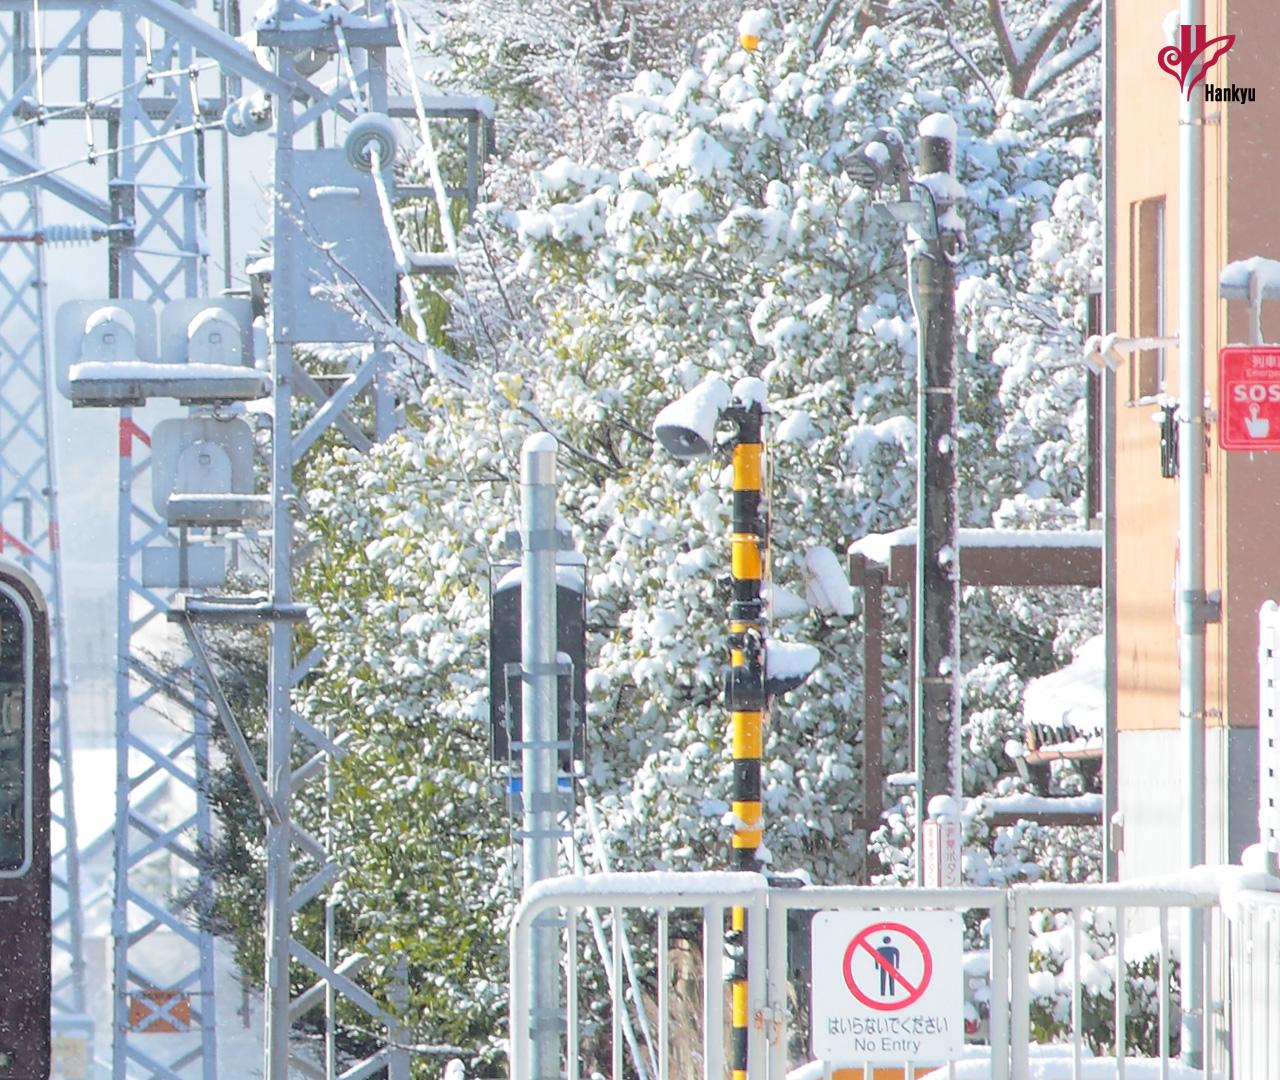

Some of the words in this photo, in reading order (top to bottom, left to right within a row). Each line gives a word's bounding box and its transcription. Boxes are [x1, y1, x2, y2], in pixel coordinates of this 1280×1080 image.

[1234, 384, 1280, 402] SOS
[827, 1015, 949, 1035] はいらないでください
[854, 1038, 876, 1052] No
[881, 1038, 921, 1055] Entry
